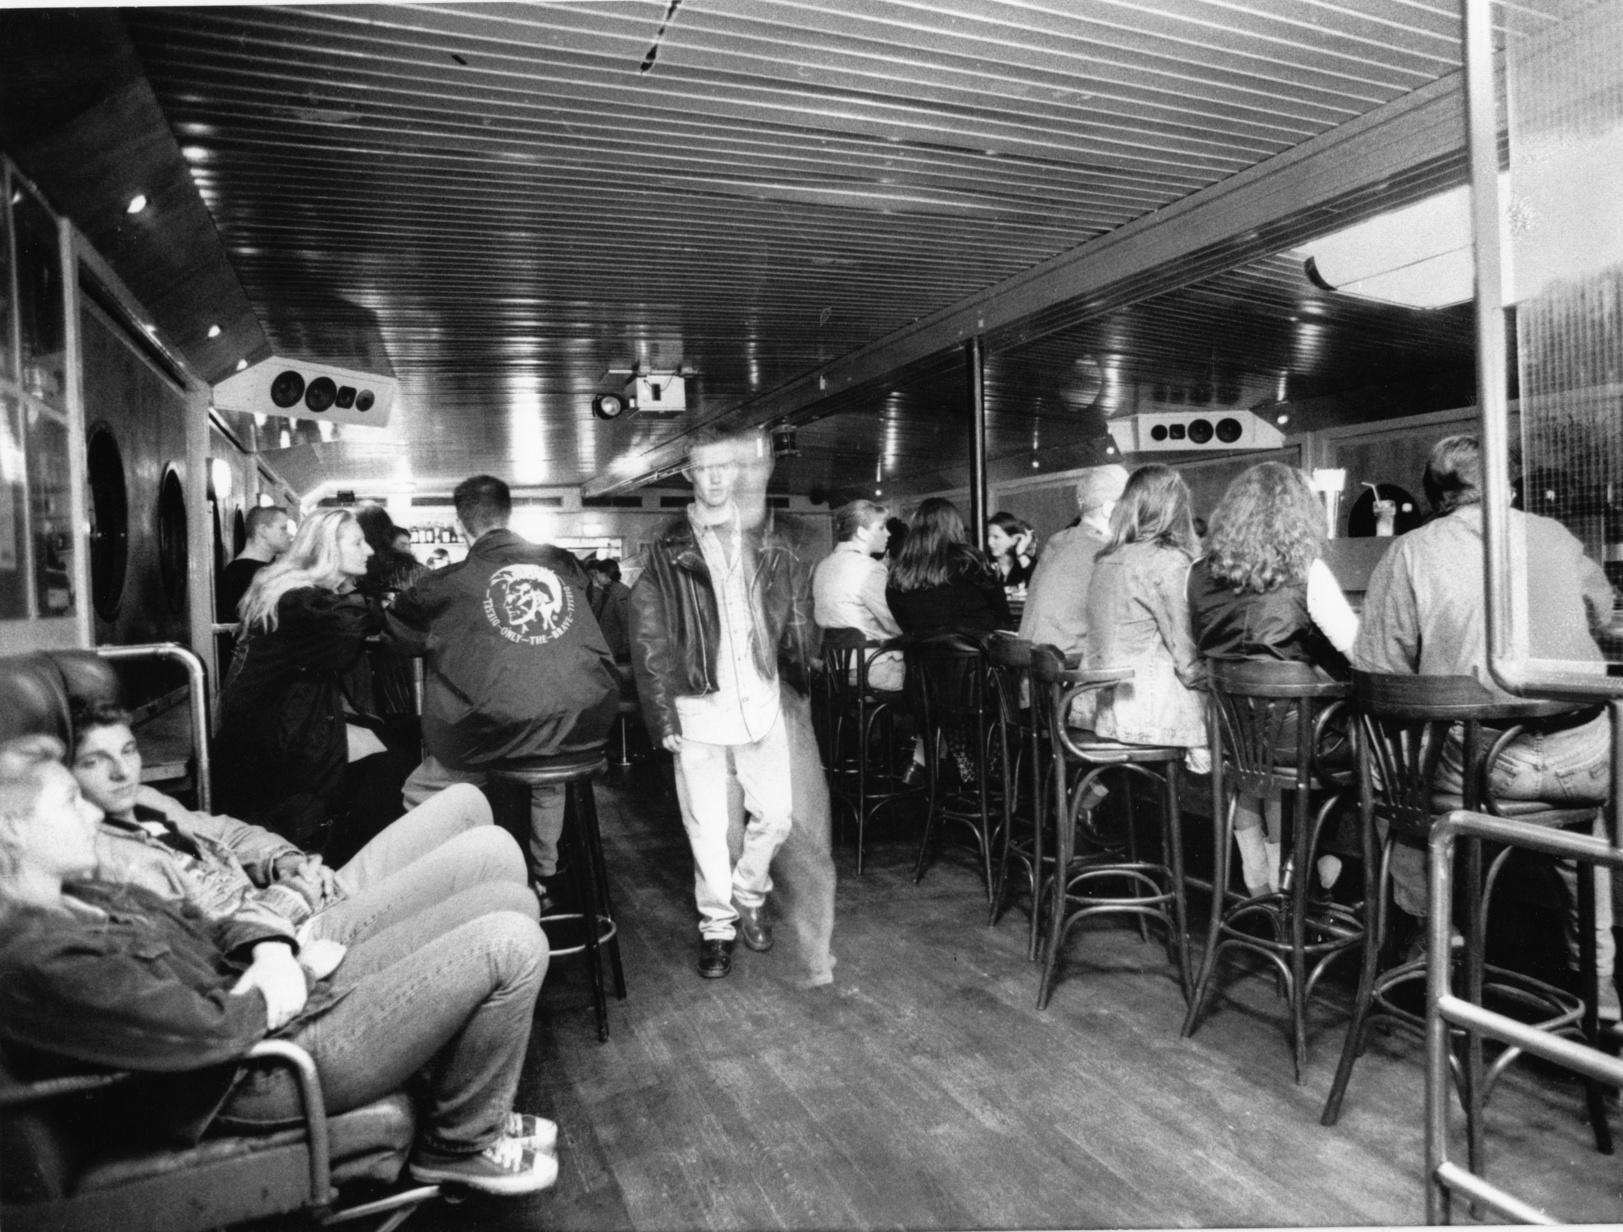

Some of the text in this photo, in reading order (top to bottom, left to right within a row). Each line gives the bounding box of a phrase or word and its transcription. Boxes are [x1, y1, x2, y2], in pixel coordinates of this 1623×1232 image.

[483, 598, 501, 627] DIESEL
[563, 586, 575, 612] DIESEL
[500, 615, 574, 645] ONLY THE BRAVE
